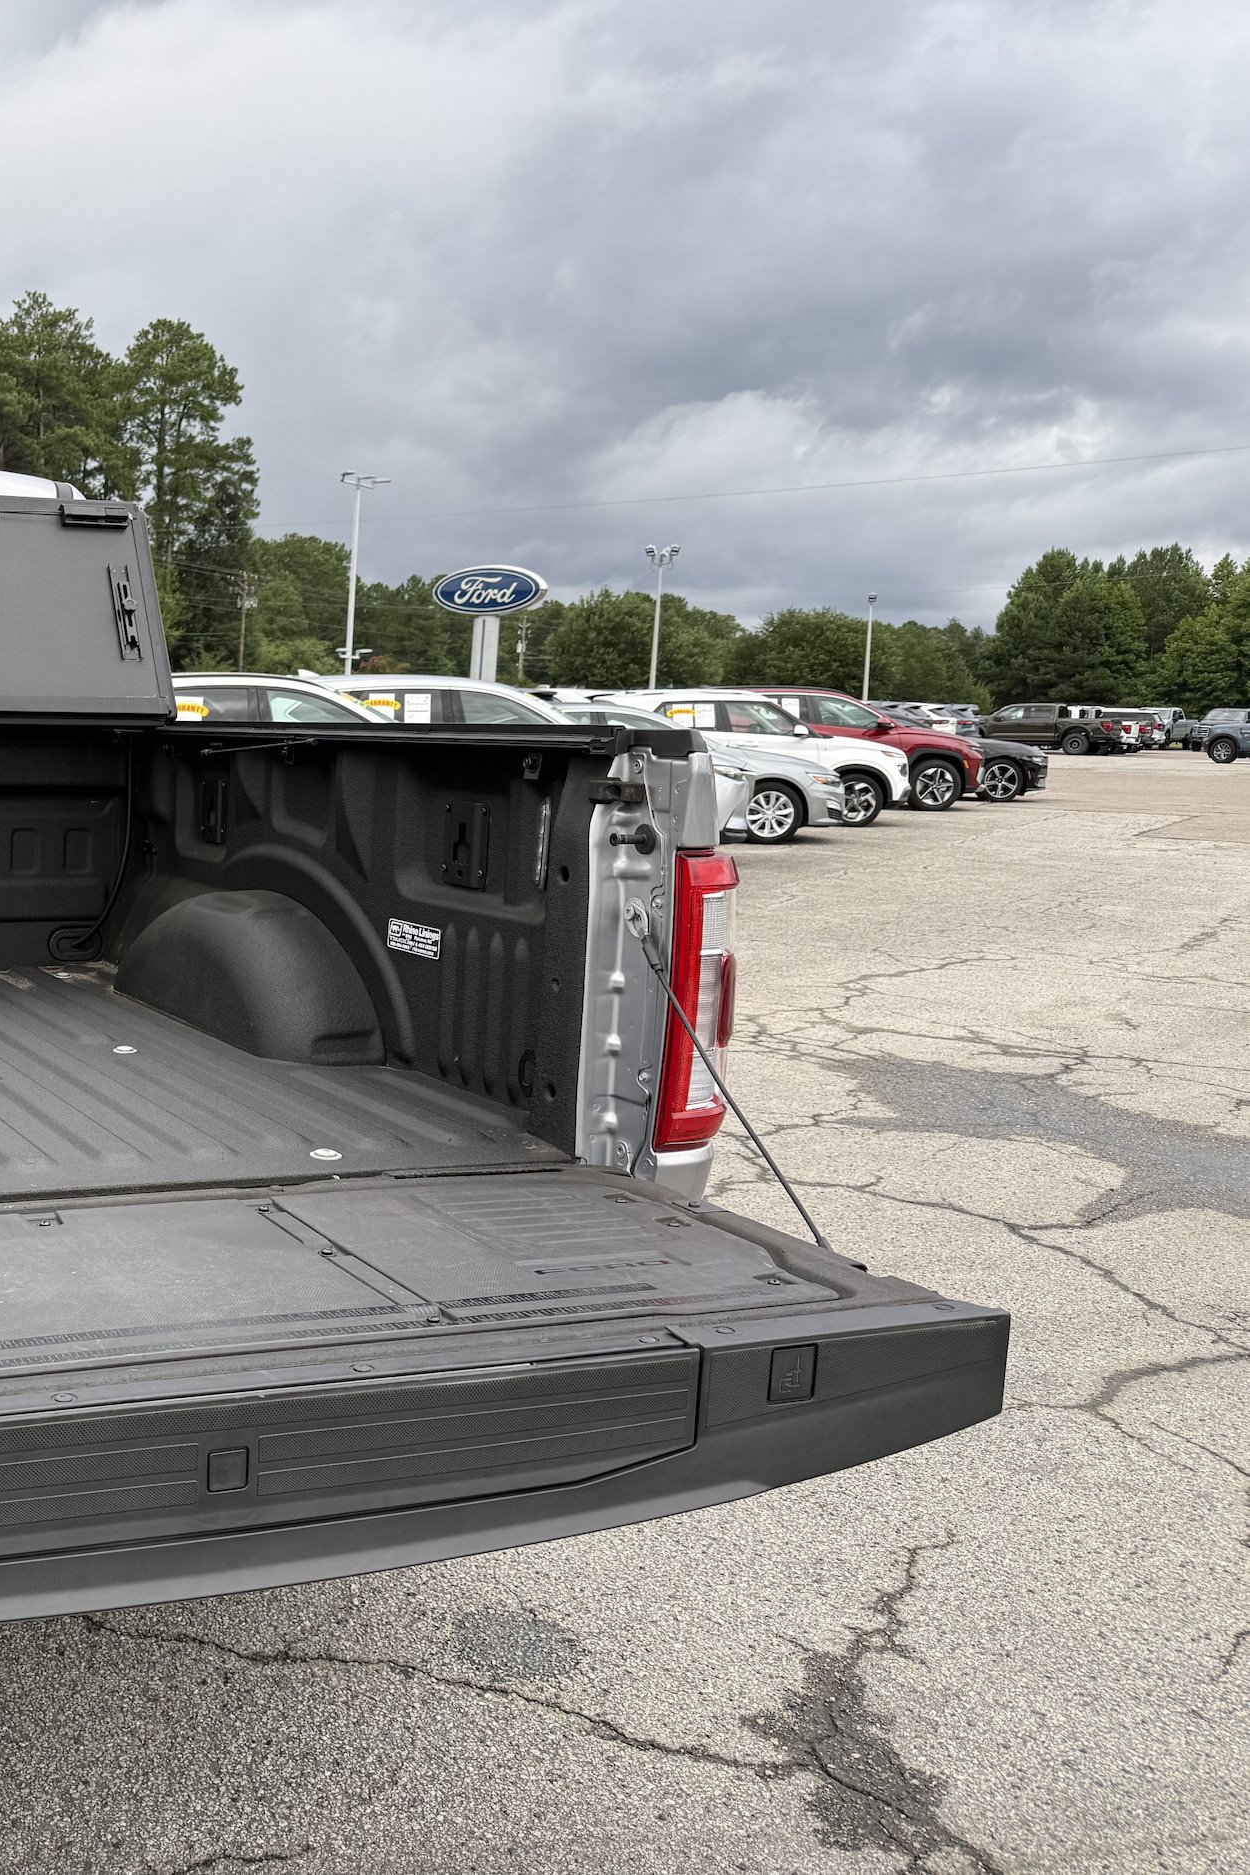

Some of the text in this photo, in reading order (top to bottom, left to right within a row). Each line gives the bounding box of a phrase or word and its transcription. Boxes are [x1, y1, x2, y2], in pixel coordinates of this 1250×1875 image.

[454, 576, 518, 604] Ford
[403, 924, 419, 935] Rhino
[418, 927, 440, 941] Linings
[534, 1260, 671, 1275] FORD
